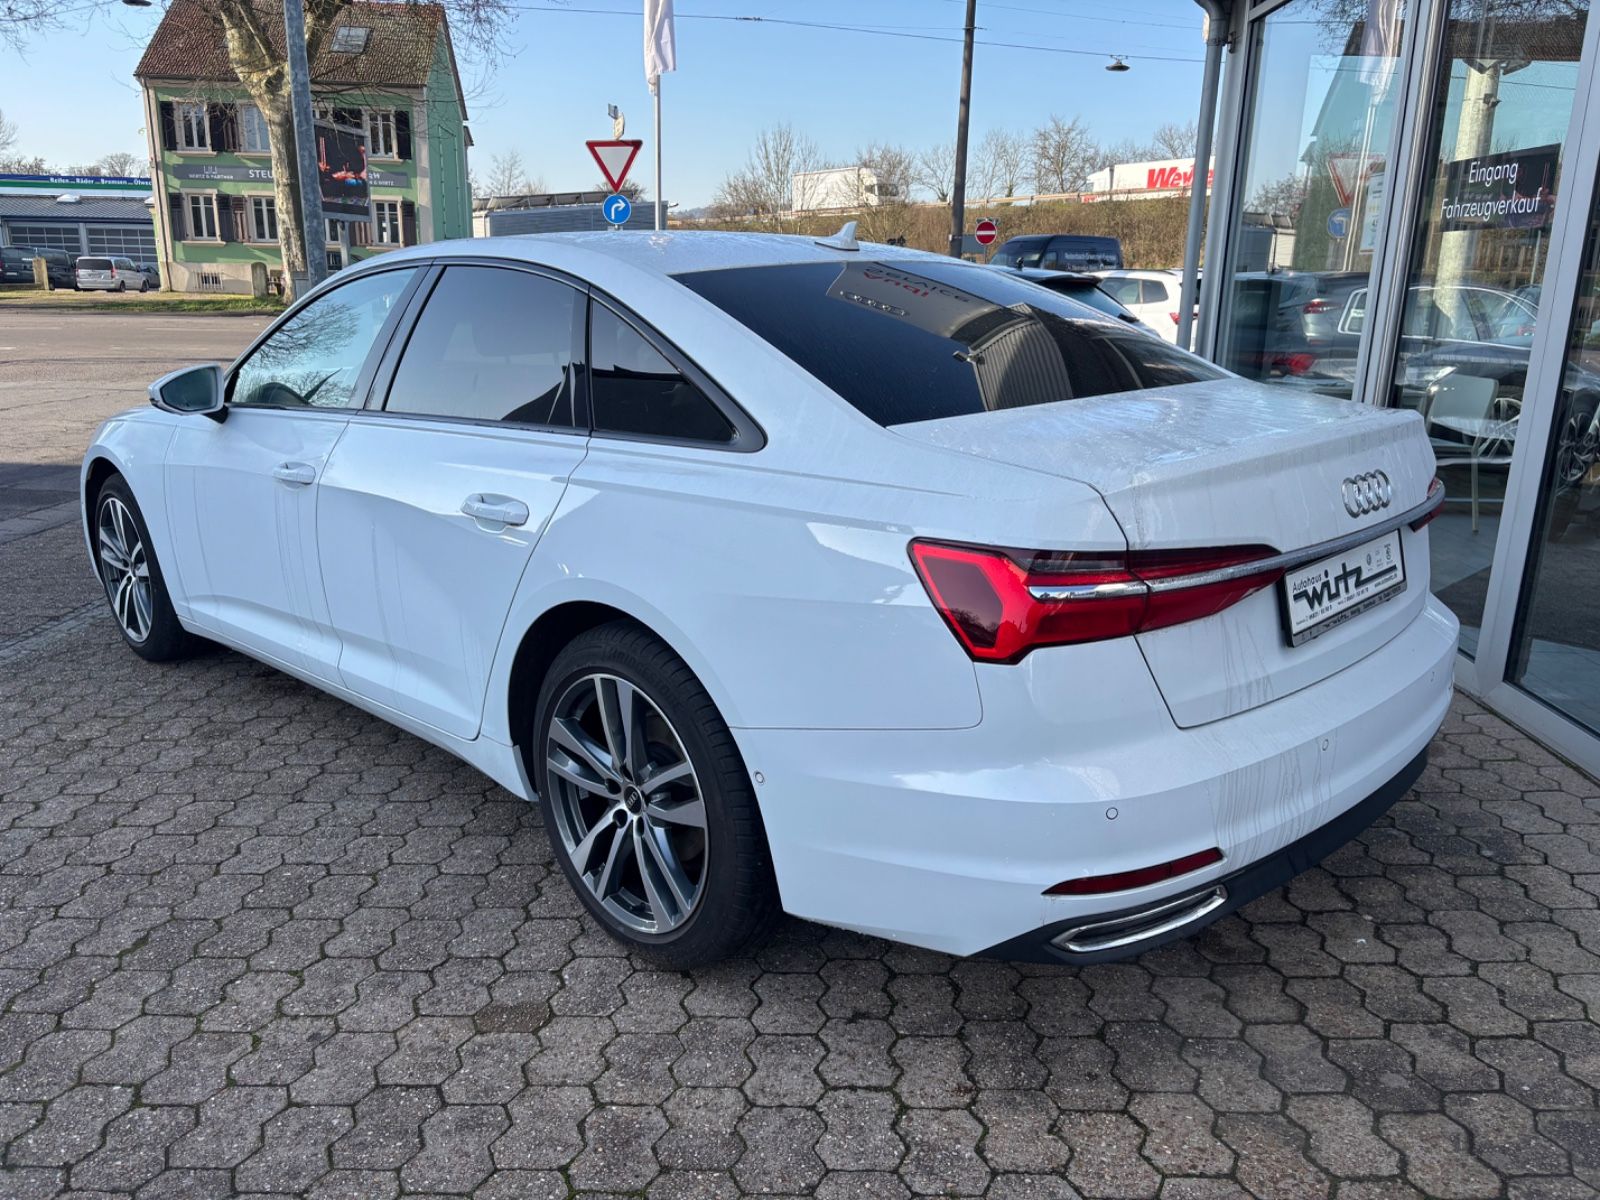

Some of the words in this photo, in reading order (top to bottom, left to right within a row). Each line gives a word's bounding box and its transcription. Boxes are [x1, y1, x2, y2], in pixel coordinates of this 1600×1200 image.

[1468, 161, 1519, 187] Eingang
[1440, 187, 1542, 221] Fahrzeugverkauf
[1292, 573, 1322, 593] Autohaus
